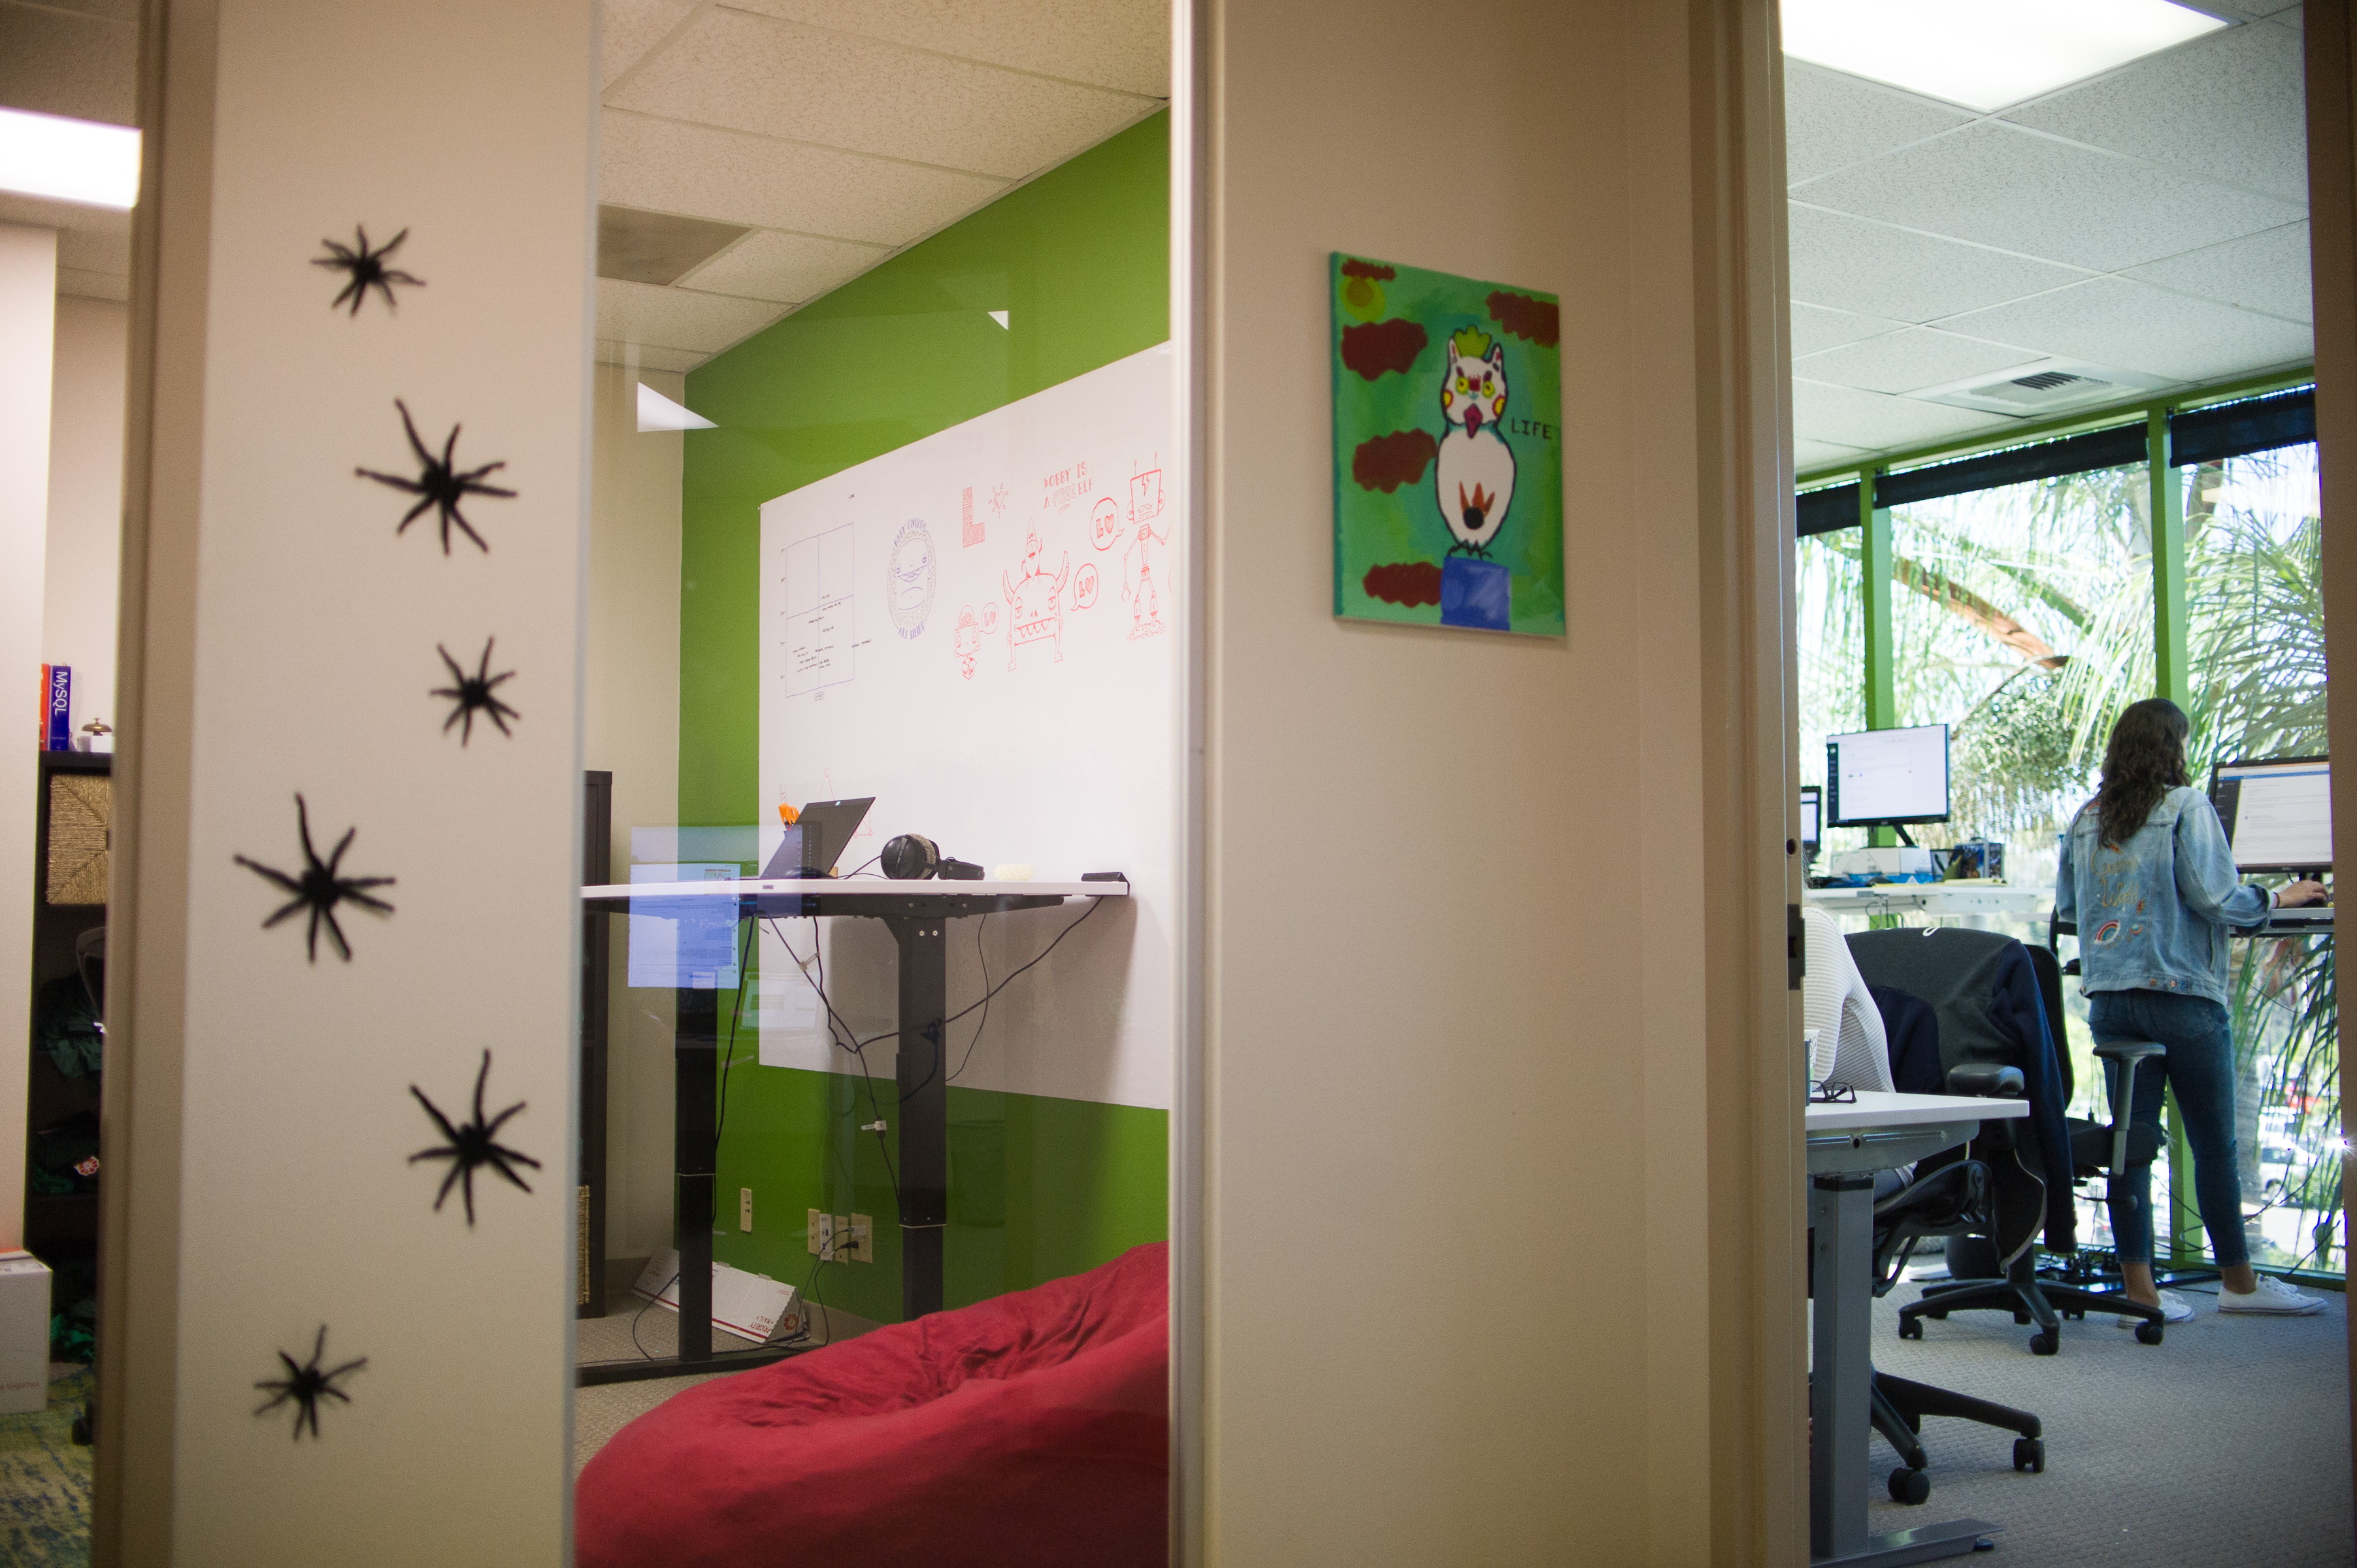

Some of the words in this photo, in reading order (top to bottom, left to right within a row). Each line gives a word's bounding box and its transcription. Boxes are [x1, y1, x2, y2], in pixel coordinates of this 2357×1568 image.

[1511, 417, 1552, 439] LIFE
[1044, 467, 1071, 490] DOBBY
[1076, 461, 1087, 478] IS
[1052, 483, 1076, 507] FREE
[1078, 476, 1093, 495] ELF
[52, 671, 68, 716] MySQL
[750, 1322, 771, 1333] PRIORITY
[760, 1316, 770, 1324] MAIL
